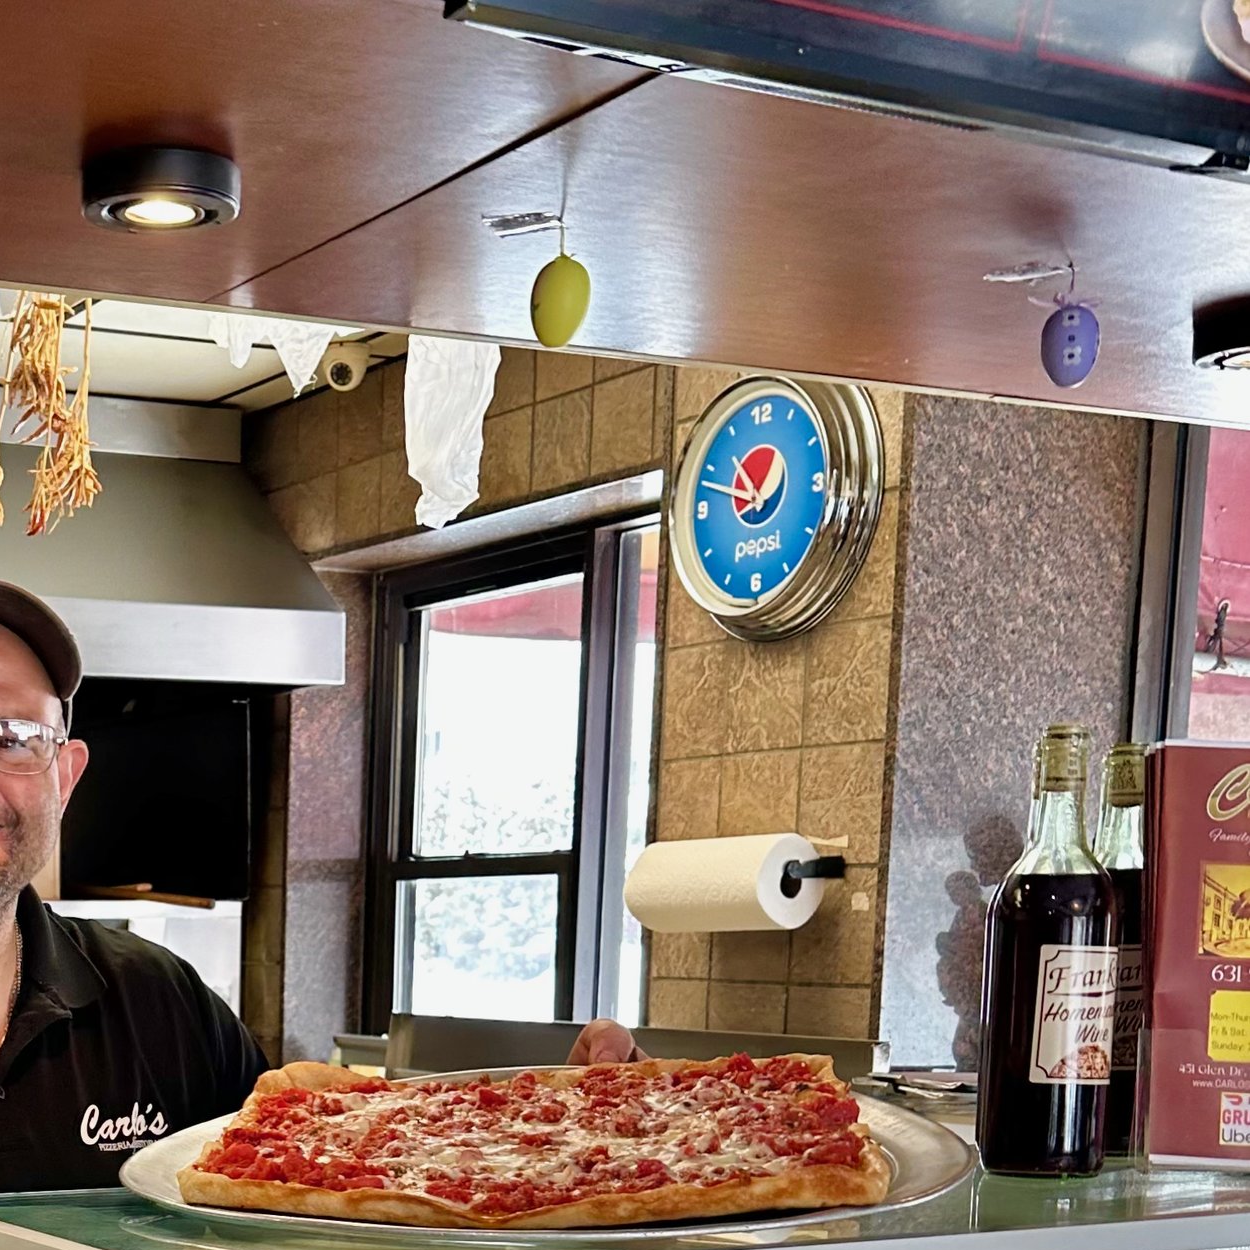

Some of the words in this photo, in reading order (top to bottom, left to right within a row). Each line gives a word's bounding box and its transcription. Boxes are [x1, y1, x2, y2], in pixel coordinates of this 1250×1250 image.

[751, 402, 773, 424] 12
[812, 472, 824, 492] 3
[697, 501, 708, 519] 9
[734, 529, 781, 562] pepsi
[750, 573, 762, 592] 6
[1075, 1023, 1110, 1044] Wine
